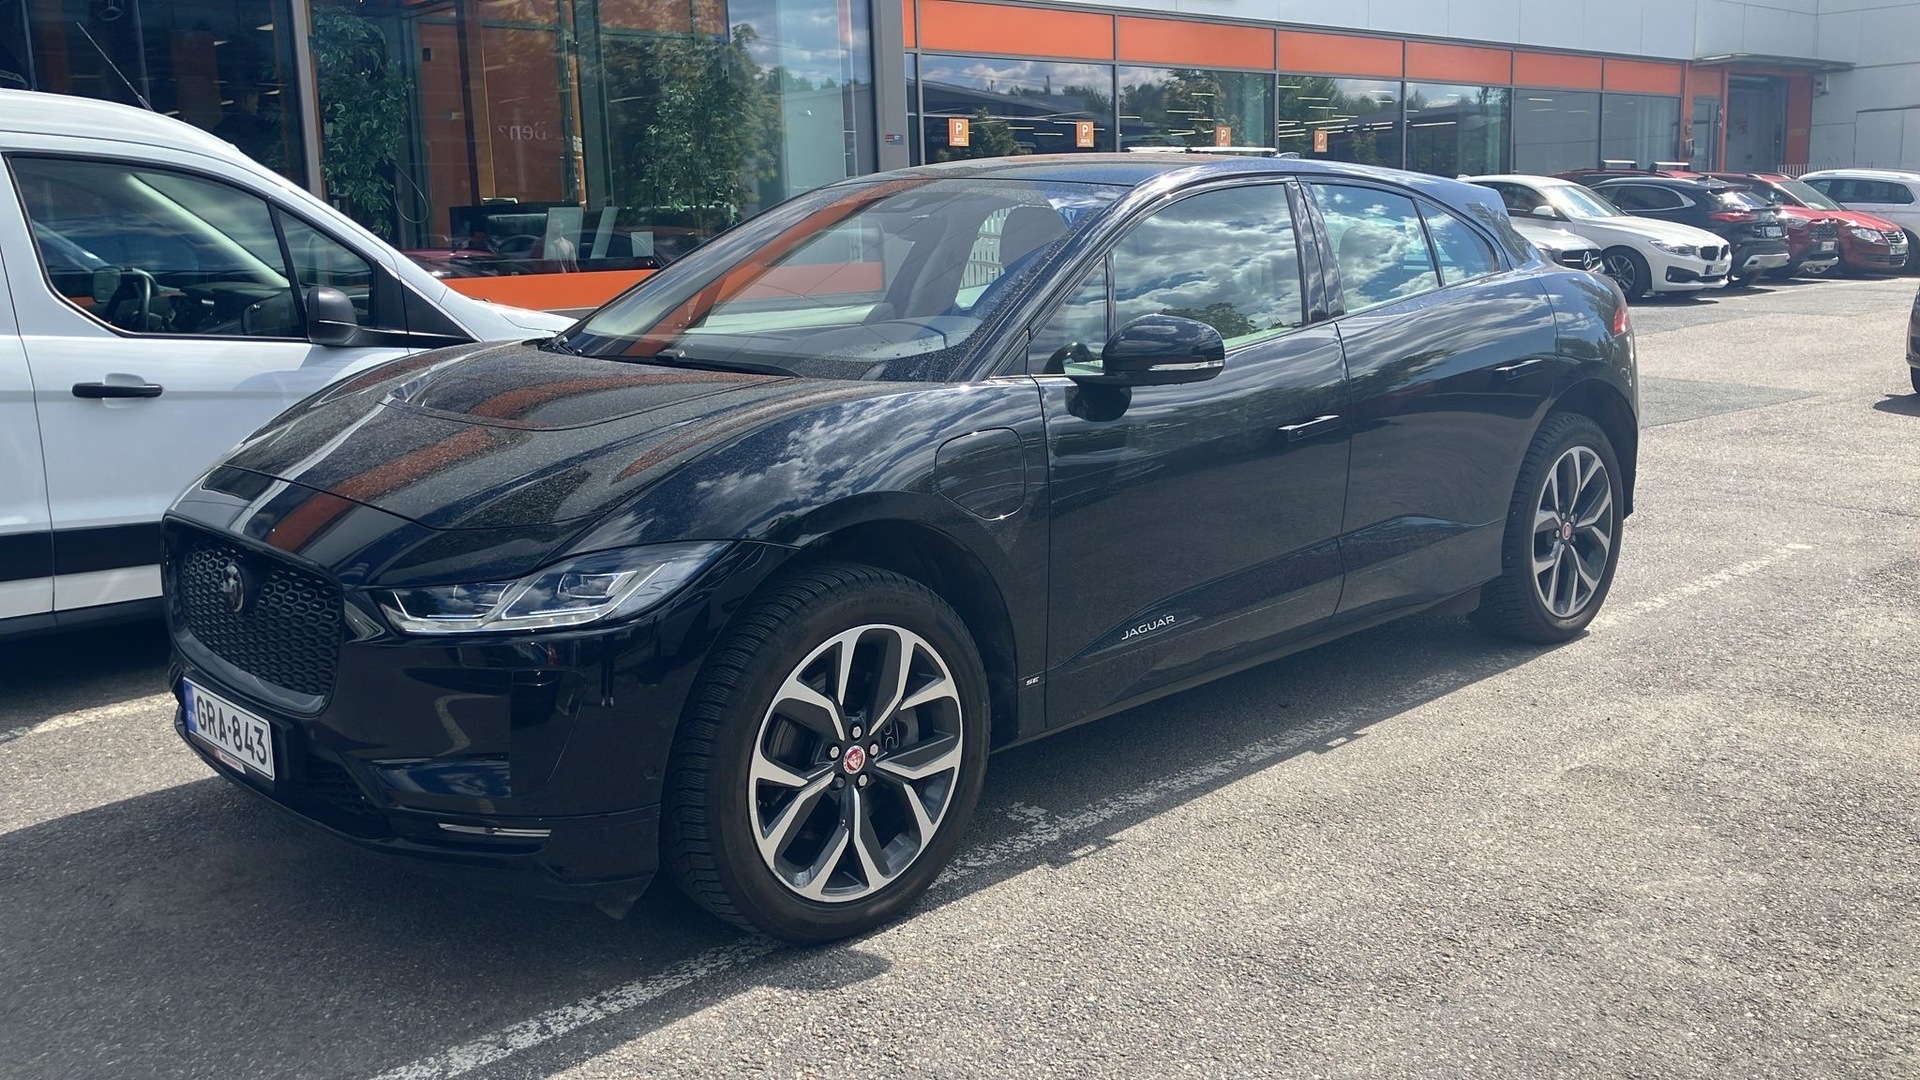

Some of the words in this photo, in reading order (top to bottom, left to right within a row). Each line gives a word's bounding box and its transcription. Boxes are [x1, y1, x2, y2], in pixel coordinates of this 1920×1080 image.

[955, 122, 963, 135] P
[1082, 124, 1089, 137] P
[1220, 129, 1227, 140] P
[1318, 133, 1324, 143] P
[1121, 615, 1175, 640] JAGUAR
[196, 695, 267, 766] GRA-843
